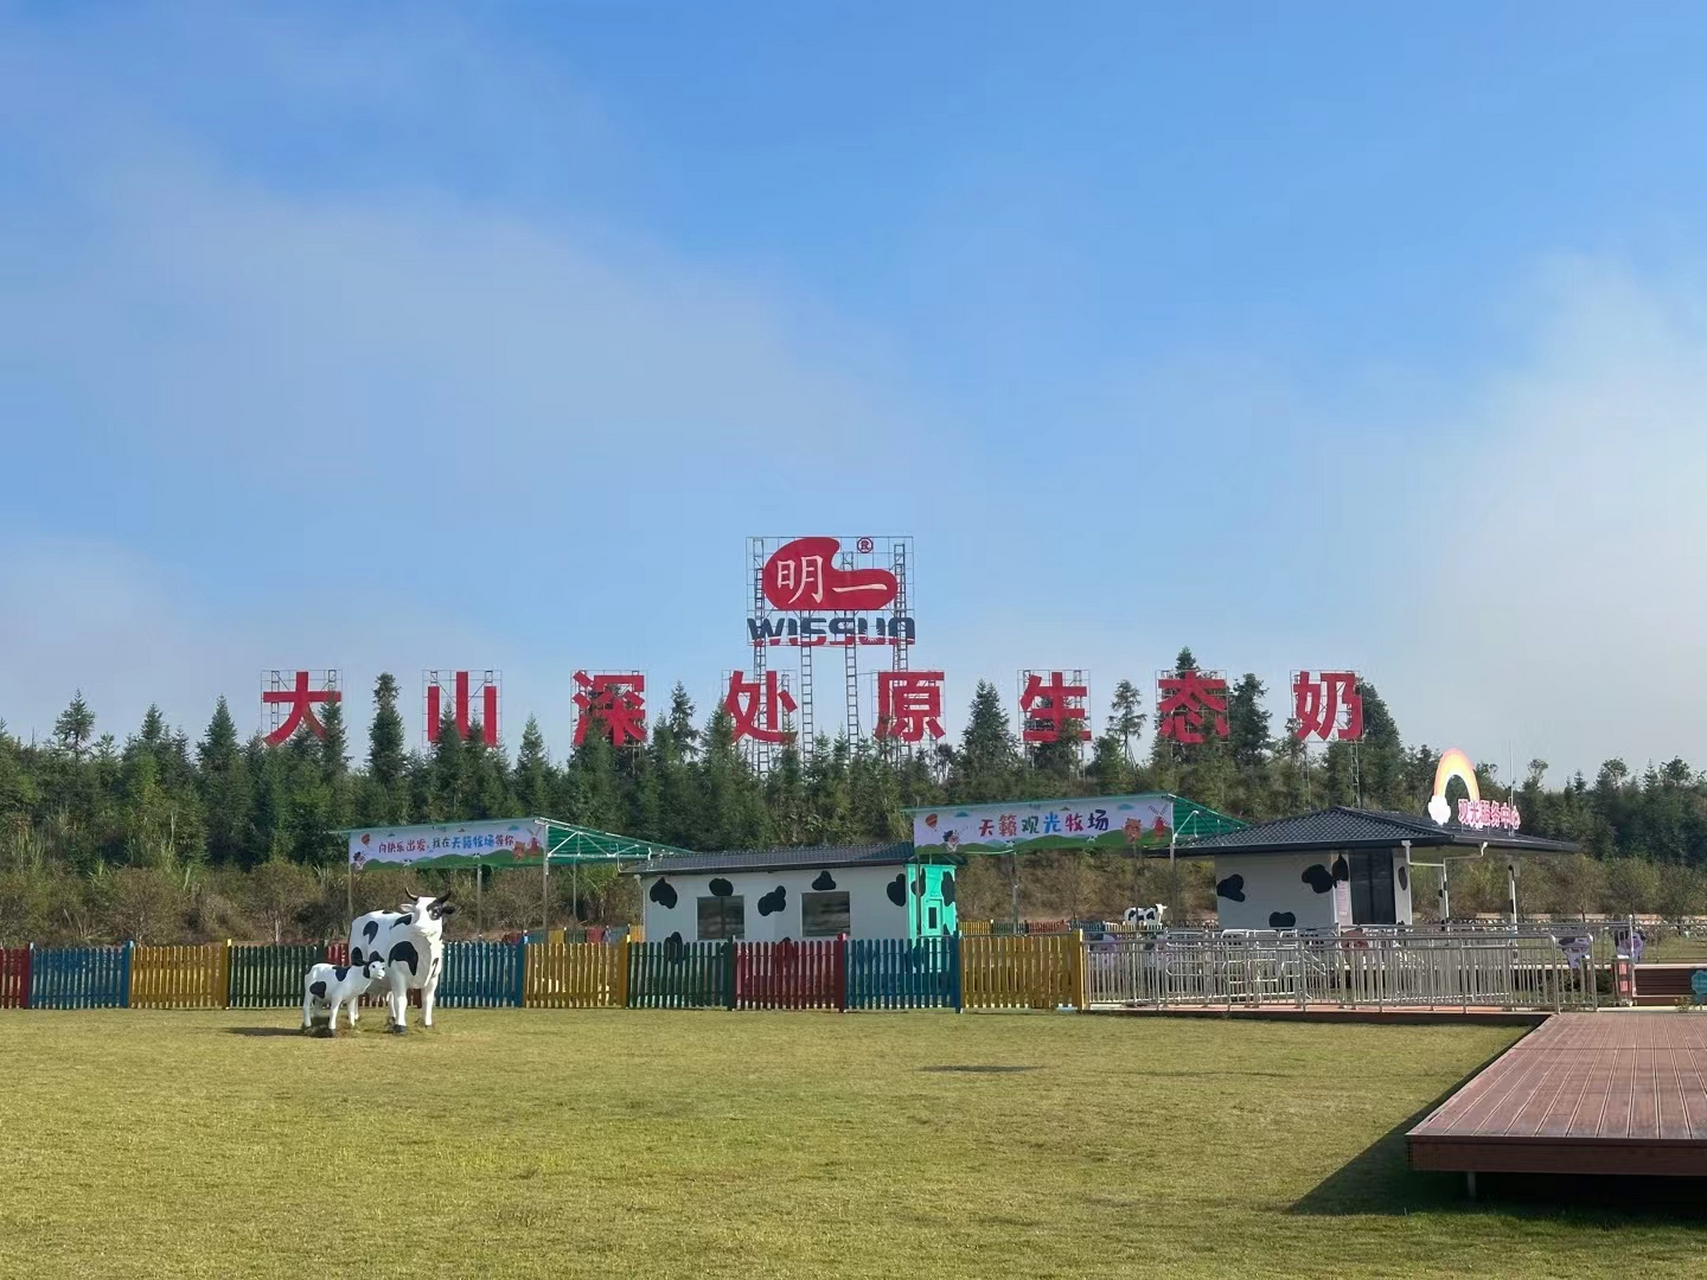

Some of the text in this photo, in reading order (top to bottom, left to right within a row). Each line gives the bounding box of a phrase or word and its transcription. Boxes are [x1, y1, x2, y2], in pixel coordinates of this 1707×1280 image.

[777, 555, 888, 605] 明一
[263, 670, 1364, 747] 大山深处原生态奶
[979, 809, 1109, 836] 天籁观光牧场
